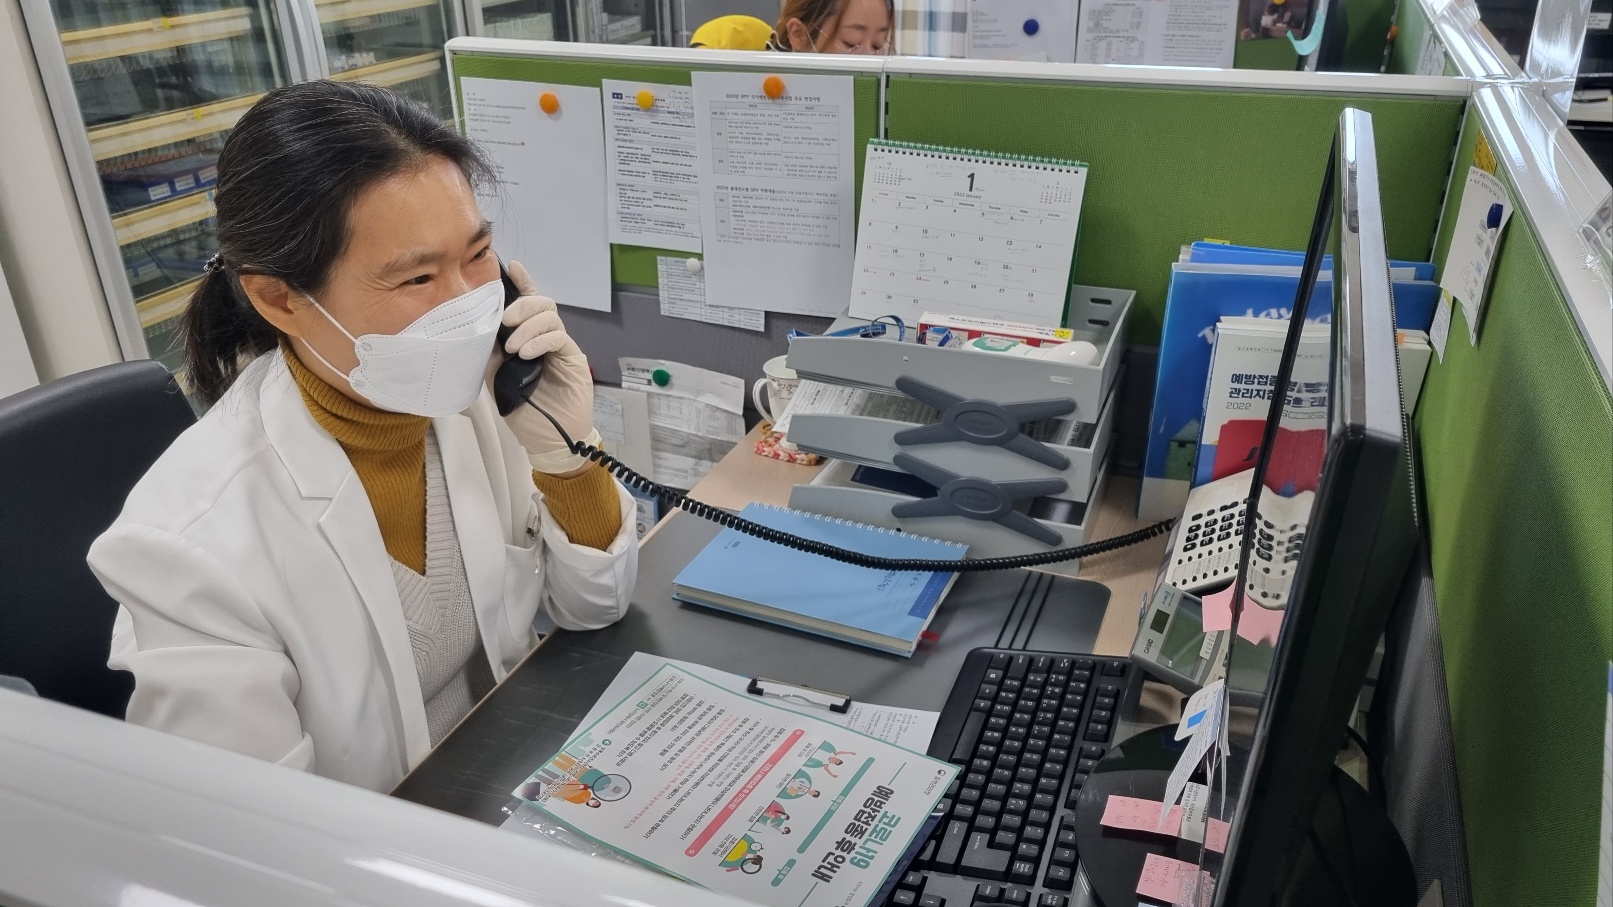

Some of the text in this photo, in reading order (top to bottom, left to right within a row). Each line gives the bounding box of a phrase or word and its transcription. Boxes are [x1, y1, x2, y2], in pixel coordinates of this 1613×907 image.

[967, 172, 976, 192] 1
[1226, 402, 1252, 410] 2022
[1144, 638, 1154, 654] CASIO
[845, 786, 892, 838] 예방접종
[835, 837, 856, 854] 후
[850, 811, 899, 868] 코로나19
[811, 852, 845, 882] 안내
